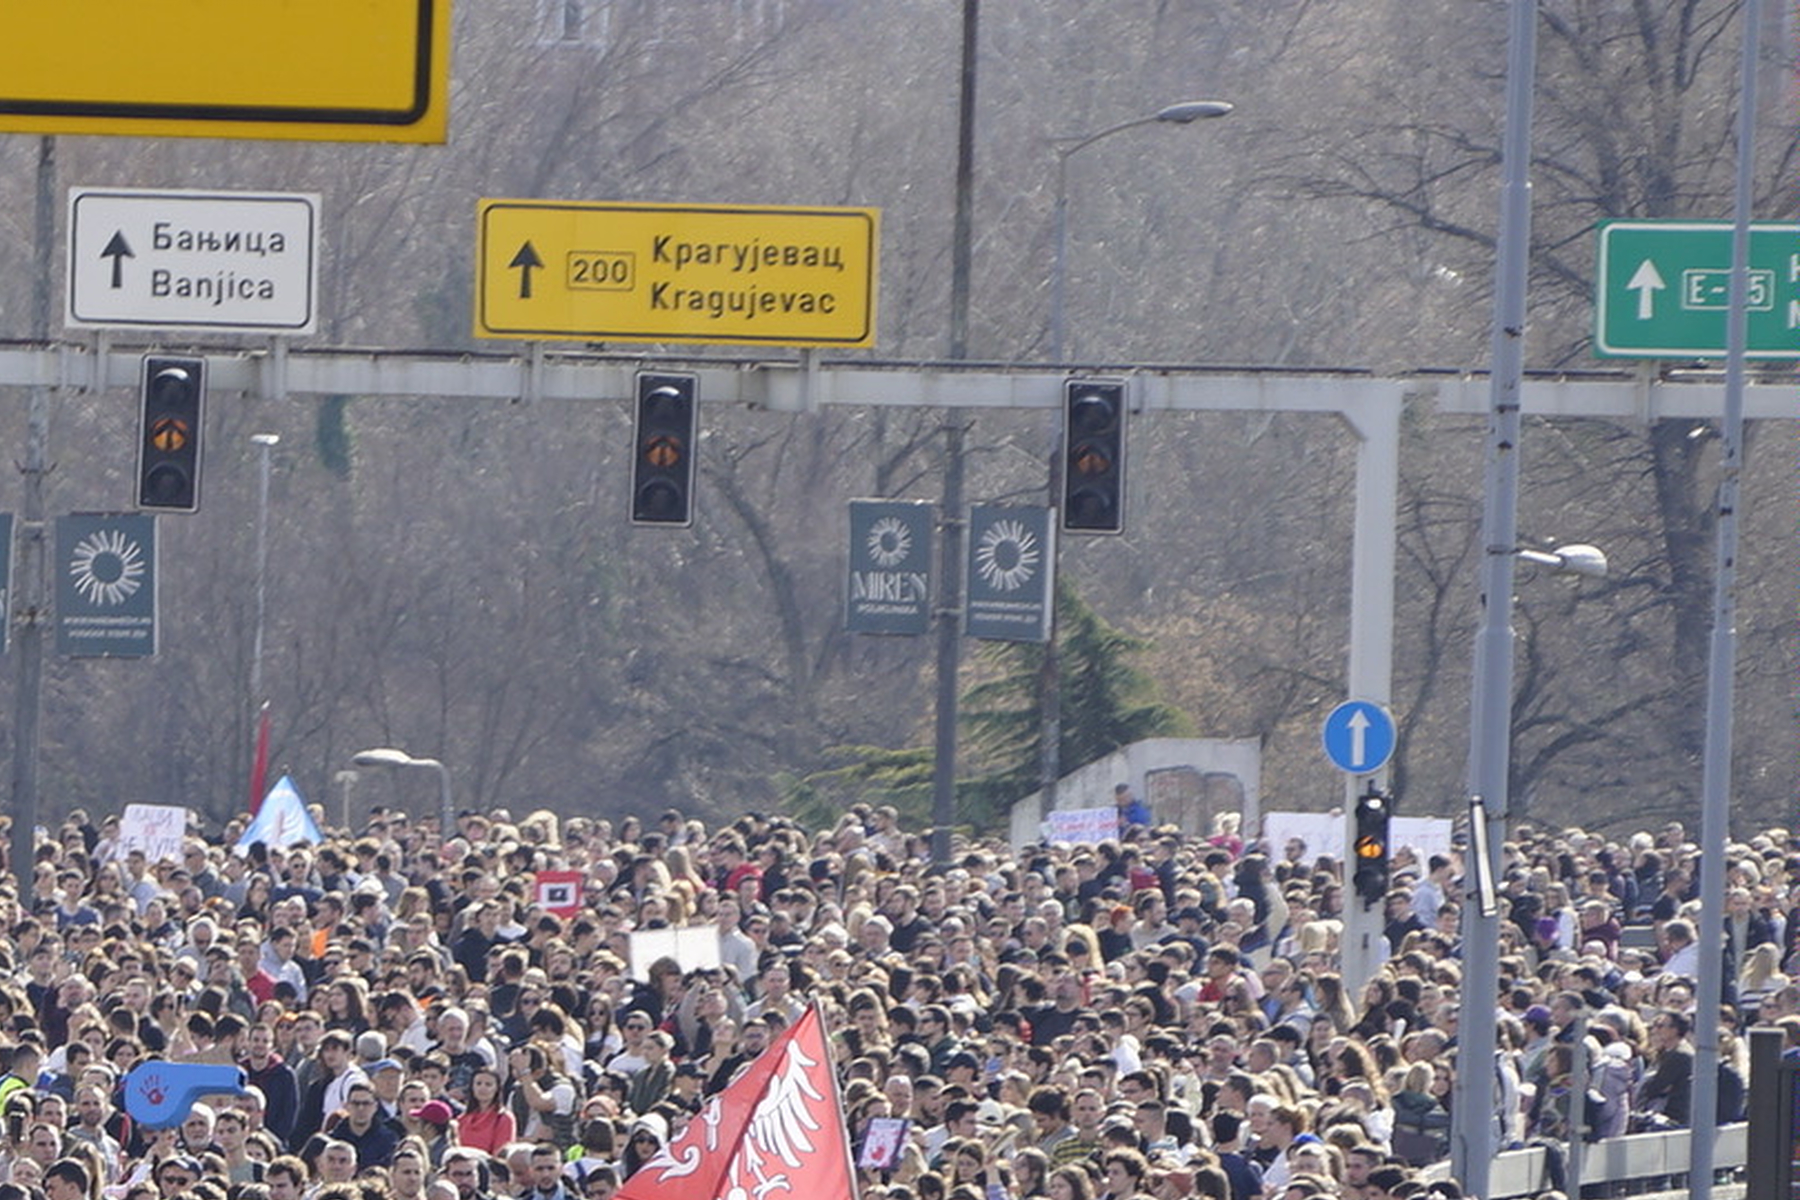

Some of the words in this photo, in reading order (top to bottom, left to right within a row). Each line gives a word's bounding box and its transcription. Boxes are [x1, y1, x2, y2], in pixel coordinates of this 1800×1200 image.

[151, 221, 286, 256] Бањица
[651, 233, 845, 274] Крагујевац
[150, 268, 275, 307] Banjica
[574, 256, 630, 285] 200
[650, 281, 836, 320] Kragujevac
